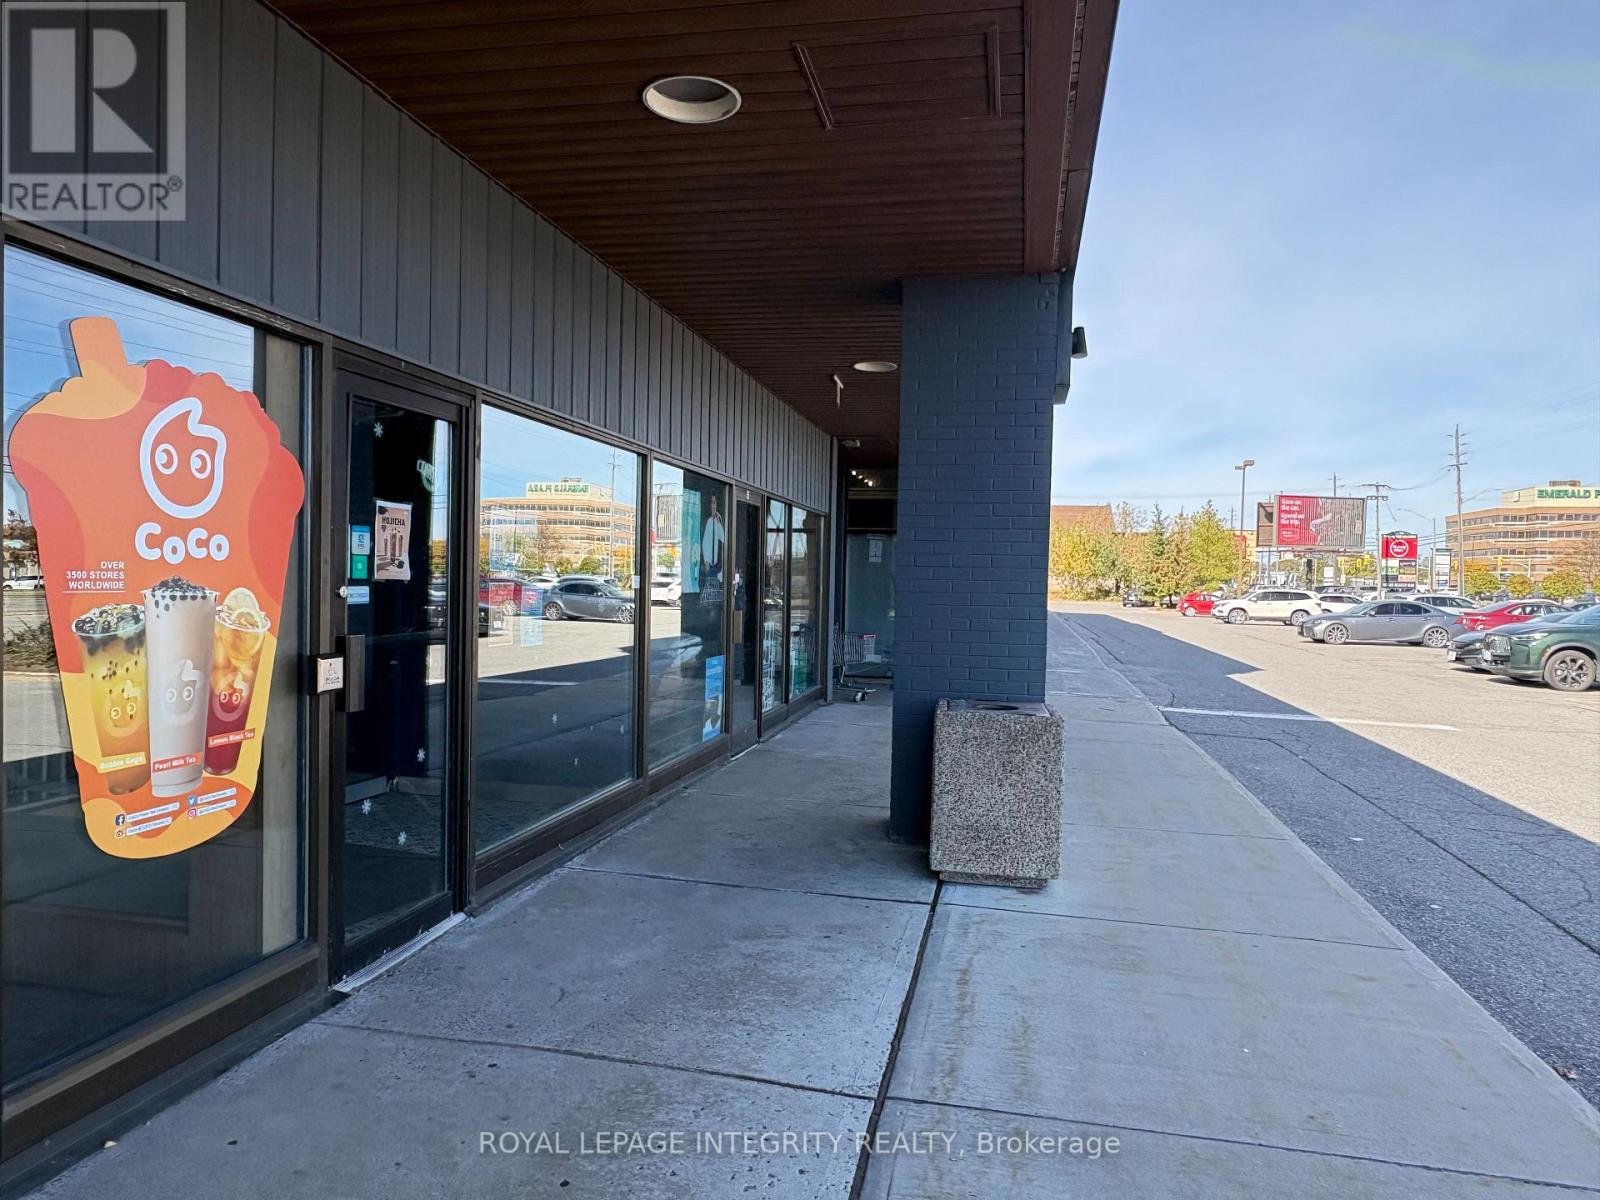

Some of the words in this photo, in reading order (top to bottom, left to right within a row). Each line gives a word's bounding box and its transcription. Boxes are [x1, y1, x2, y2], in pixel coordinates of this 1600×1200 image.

[1537, 489, 1591, 499] EMERALD
[100, 561, 125, 570] OVER
[66, 571, 87, 579] 3500
[89, 571, 125, 579] STORES
[68, 581, 125, 590] WORLDWIDE
[209, 736, 228, 745] Lemon
[229, 733, 244, 742] Black
[244, 731, 254, 739] Tea
[154, 761, 171, 771] Pearl
[172, 759, 185, 768] Milk
[185, 756, 196, 765] Tea
